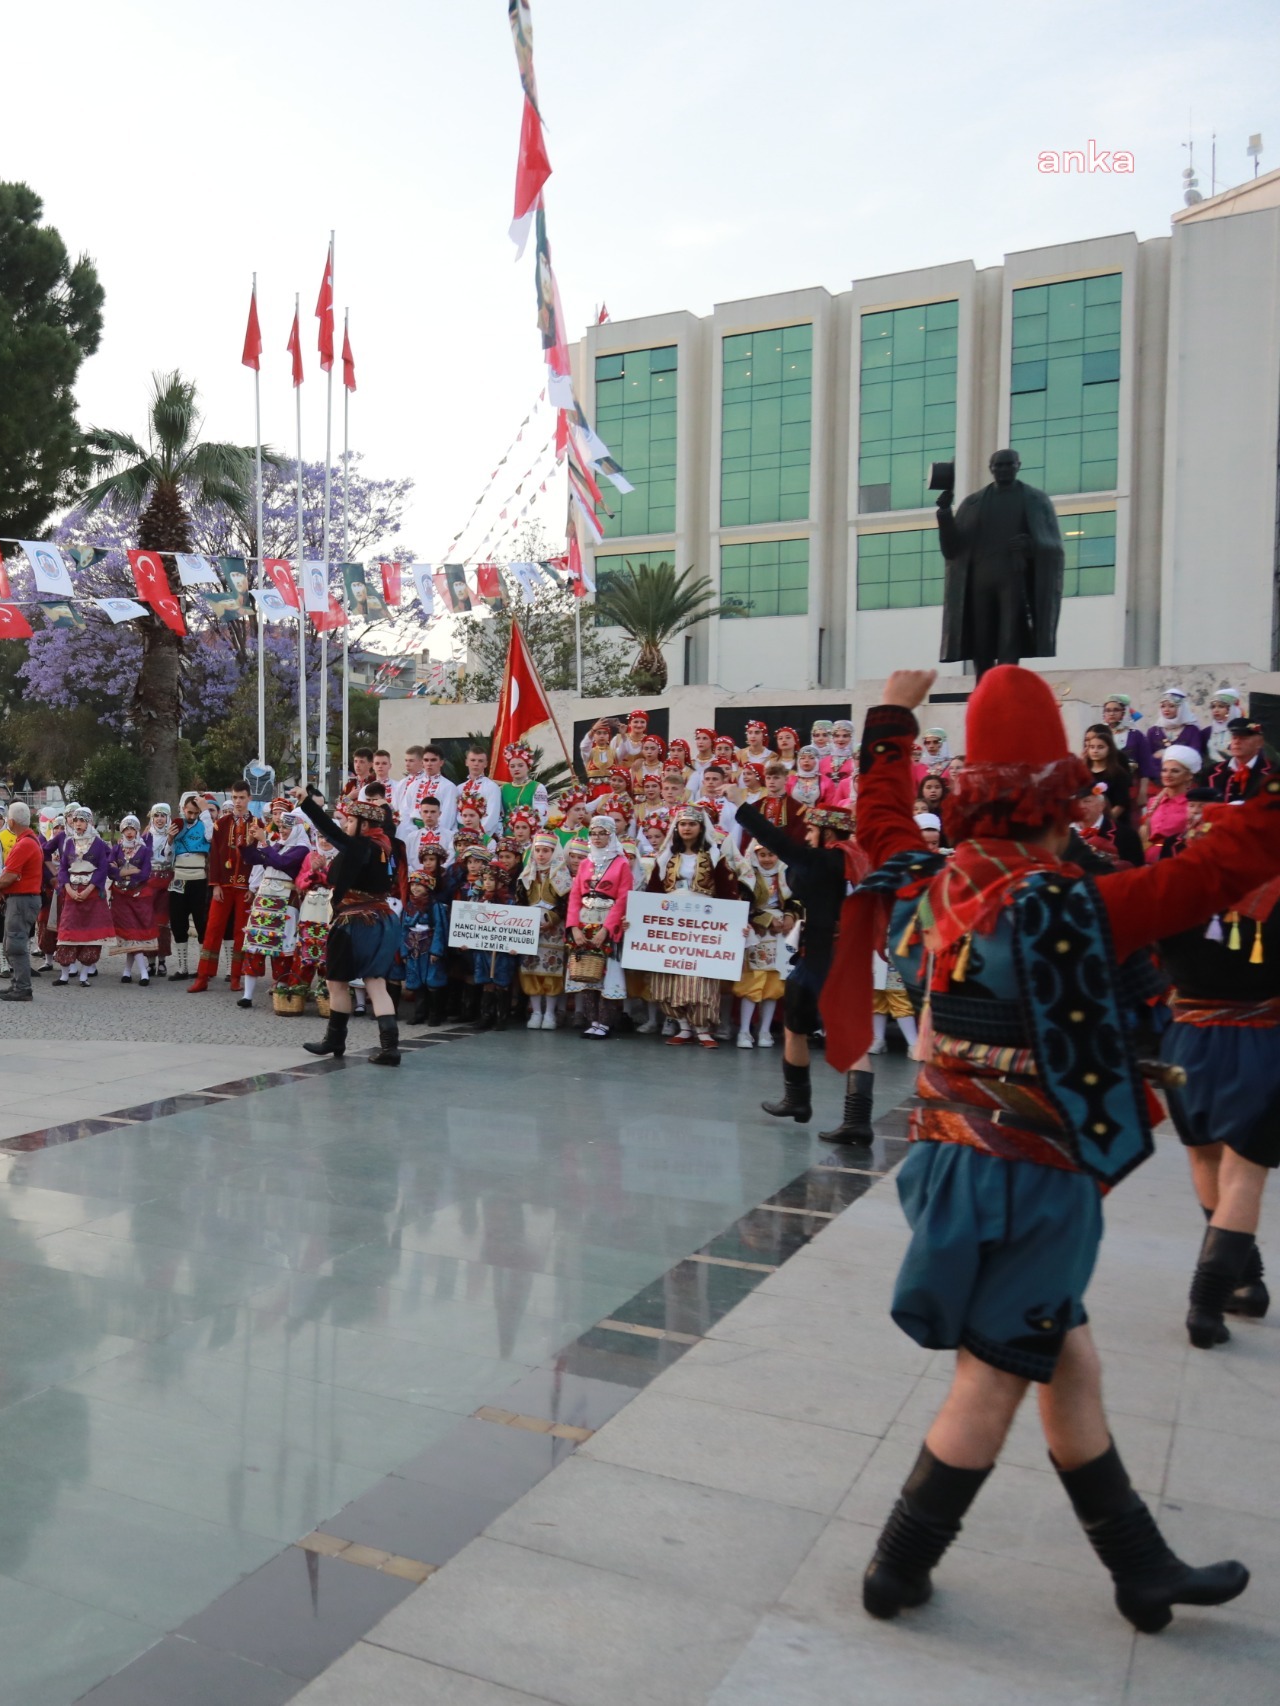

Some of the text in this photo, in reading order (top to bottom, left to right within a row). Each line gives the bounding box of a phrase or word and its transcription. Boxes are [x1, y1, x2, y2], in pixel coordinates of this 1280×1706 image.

[454, 923, 534, 936] HANCI HALK OYUNLARI
[642, 914, 729, 931] EFES SELÇUK
[452, 931, 480, 940] GENÇLİK
[508, 936, 535, 945] KULÜBÜ
[647, 929, 722, 945] BELEDİYESİ
[480, 941, 504, 950] İZMİR
[630, 941, 736, 961] HALK OYUNLARI
[663, 958, 697, 971] EKİBİ
